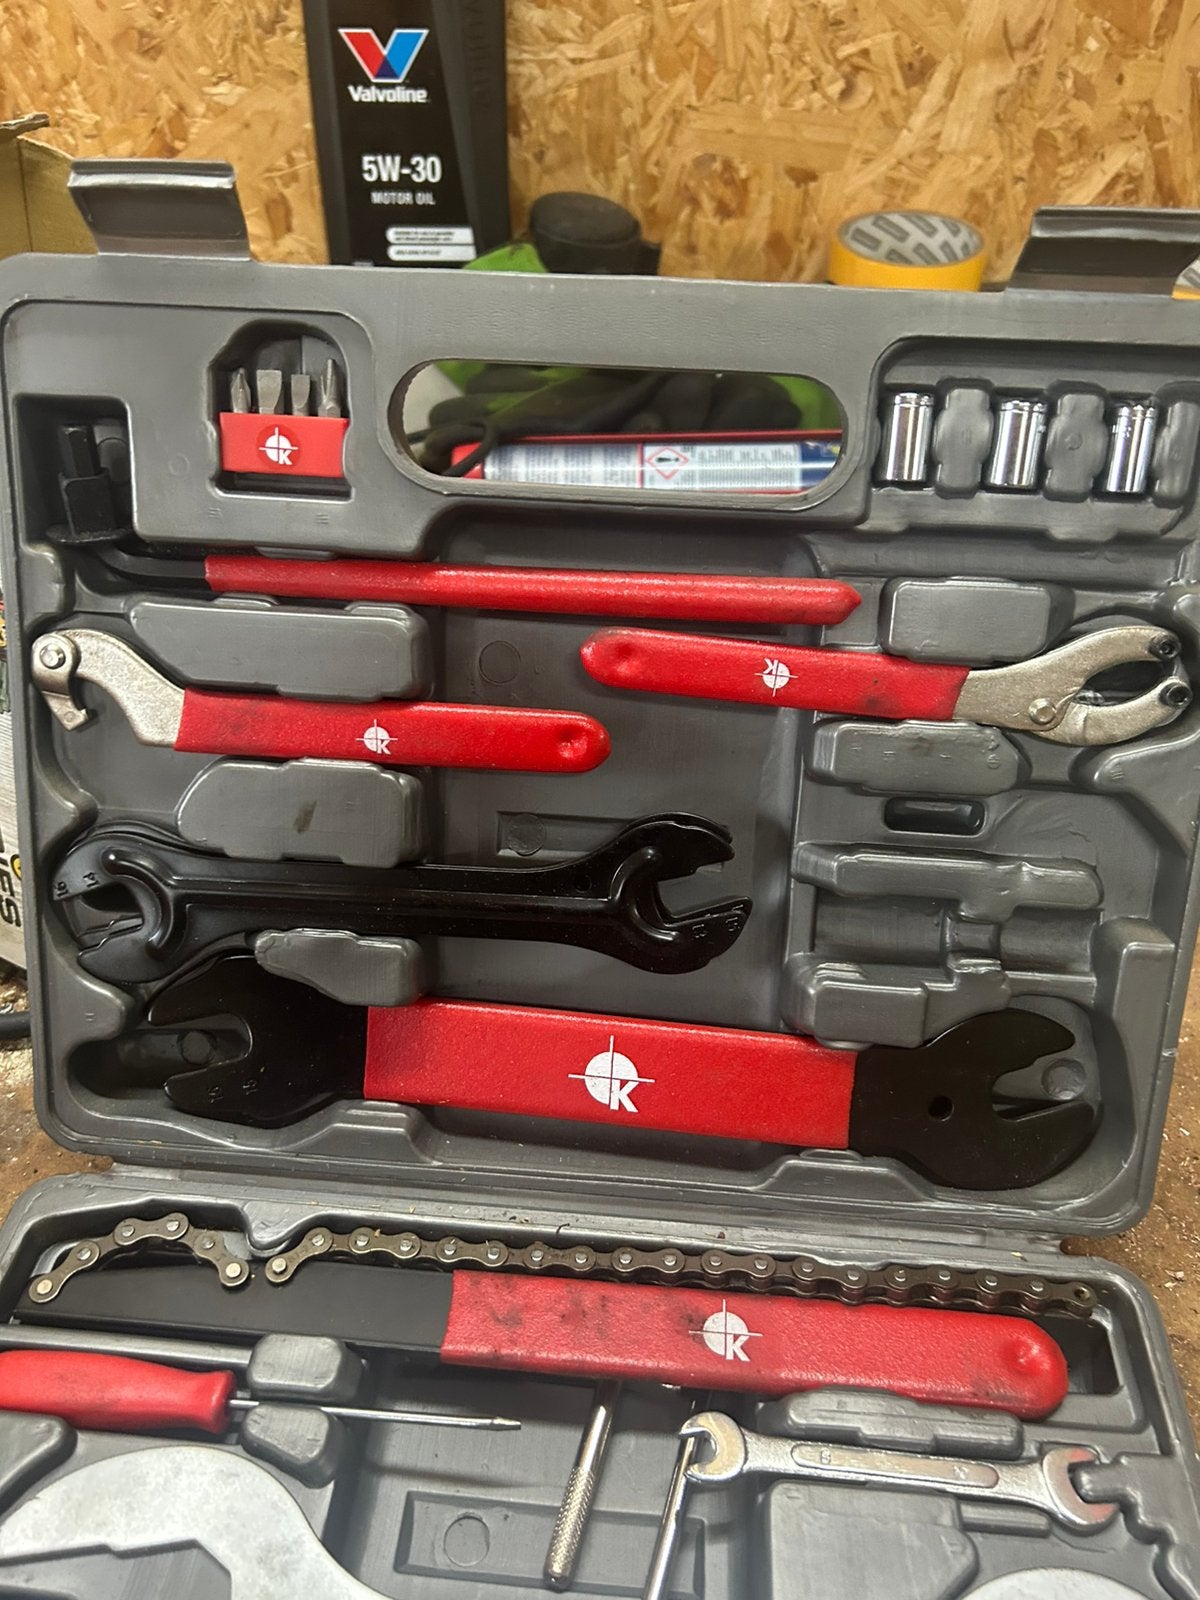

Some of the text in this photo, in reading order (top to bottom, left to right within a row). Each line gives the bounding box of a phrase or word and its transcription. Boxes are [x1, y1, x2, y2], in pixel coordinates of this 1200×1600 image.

[348, 85, 428, 103] Valvoline
[362, 154, 442, 183] 5W-30
[371, 191, 436, 205] MOTOR OIL
